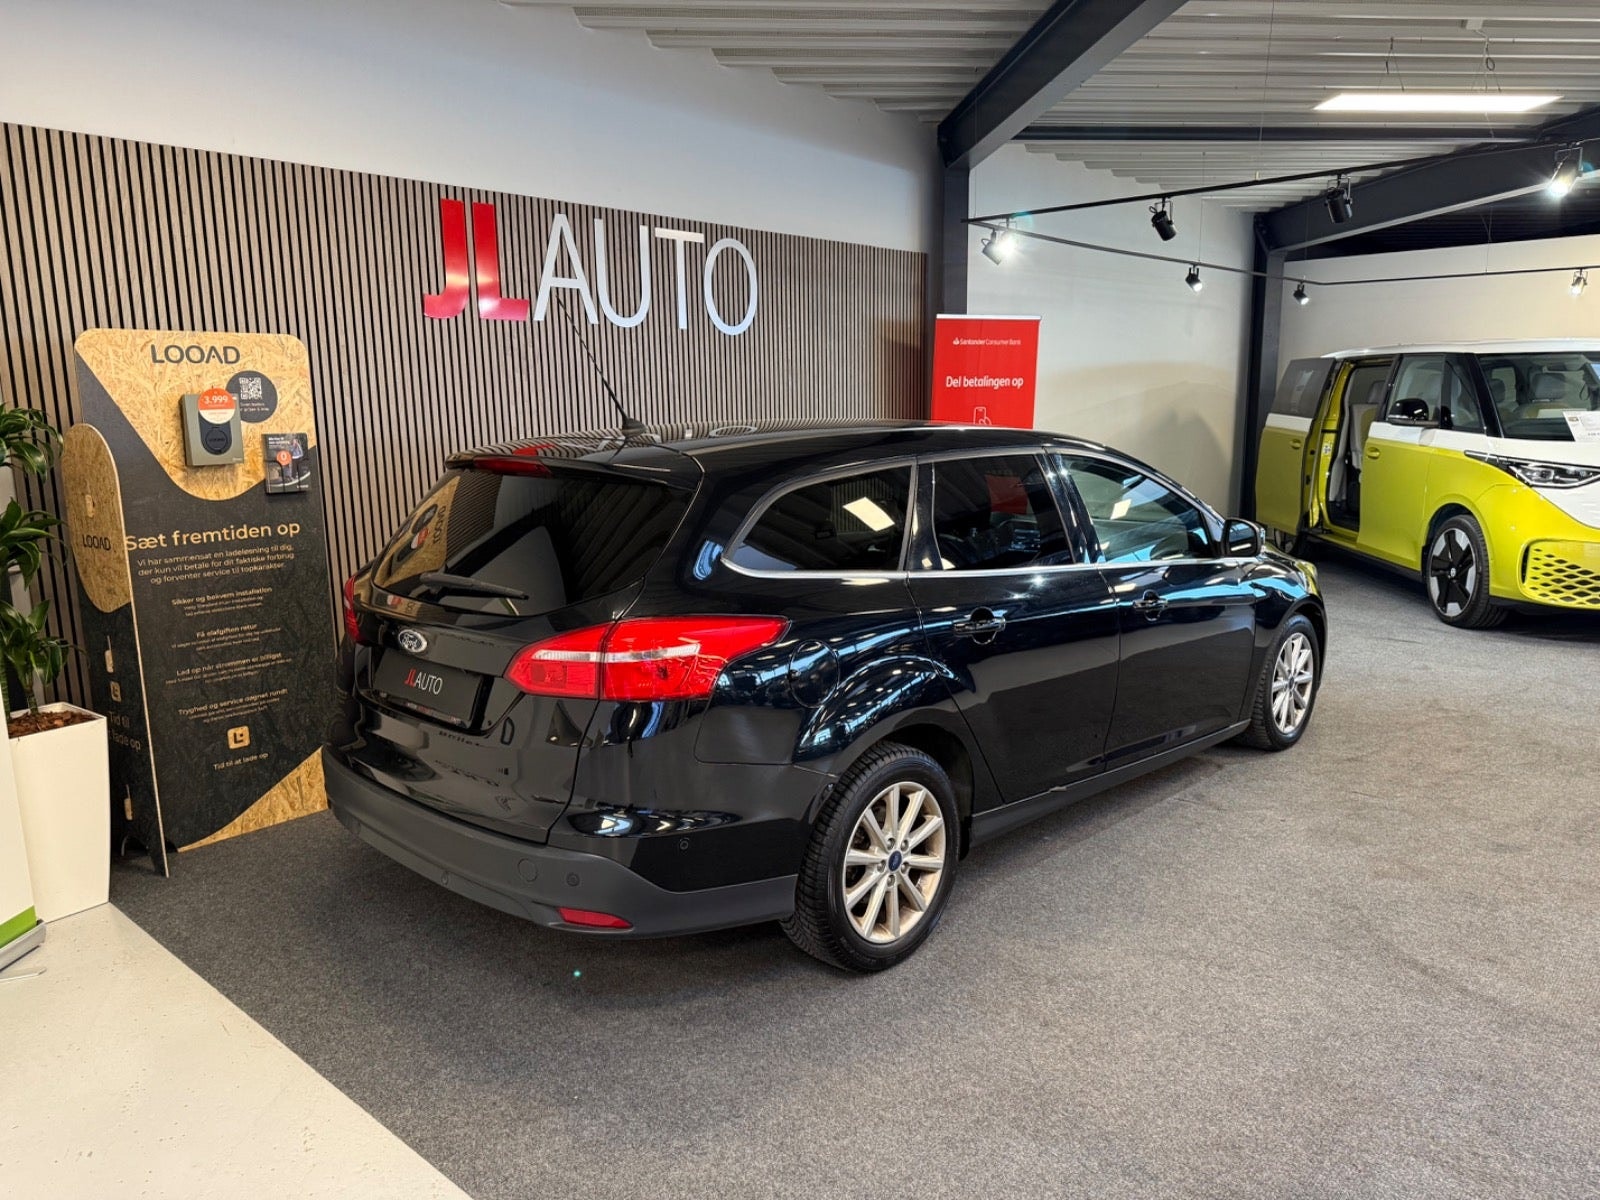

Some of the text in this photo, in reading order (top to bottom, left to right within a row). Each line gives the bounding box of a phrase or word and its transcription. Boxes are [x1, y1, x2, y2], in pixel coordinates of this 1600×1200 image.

[960, 338, 1021, 346] Santander Consumer Bank
[945, 375, 1024, 390] Del betalingen op
[125, 523, 300, 551] Sæt fremtiden op
[137, 558, 146, 567] Vi
[148, 557, 161, 566] har
[164, 552, 212, 564] sammensat
[213, 551, 224, 559] en
[270, 544, 279, 552] til
[138, 568, 153, 577] der
[155, 566, 171, 574] kun
[172, 564, 182, 572] vil
[184, 562, 210, 571] betale
[211, 560, 222, 568] for
[236, 555, 266, 565] faktiske
[267, 552, 295, 561] forbrug
[150, 577, 162, 586] og
[163, 572, 201, 583] forventer
[202, 568, 231, 578] service
[171, 597, 194, 606] Sikker
[235, 587, 273, 597] installation
[196, 631, 206, 639] Få
[176, 668, 190, 677] Lad
[191, 667, 201, 675] op
[202, 663, 214, 672] når
[178, 705, 208, 716] Tryghed
[209, 703, 219, 711] og
[220, 697, 244, 707] service
[129, 738, 141, 752] op
[258, 752, 269, 760] op
